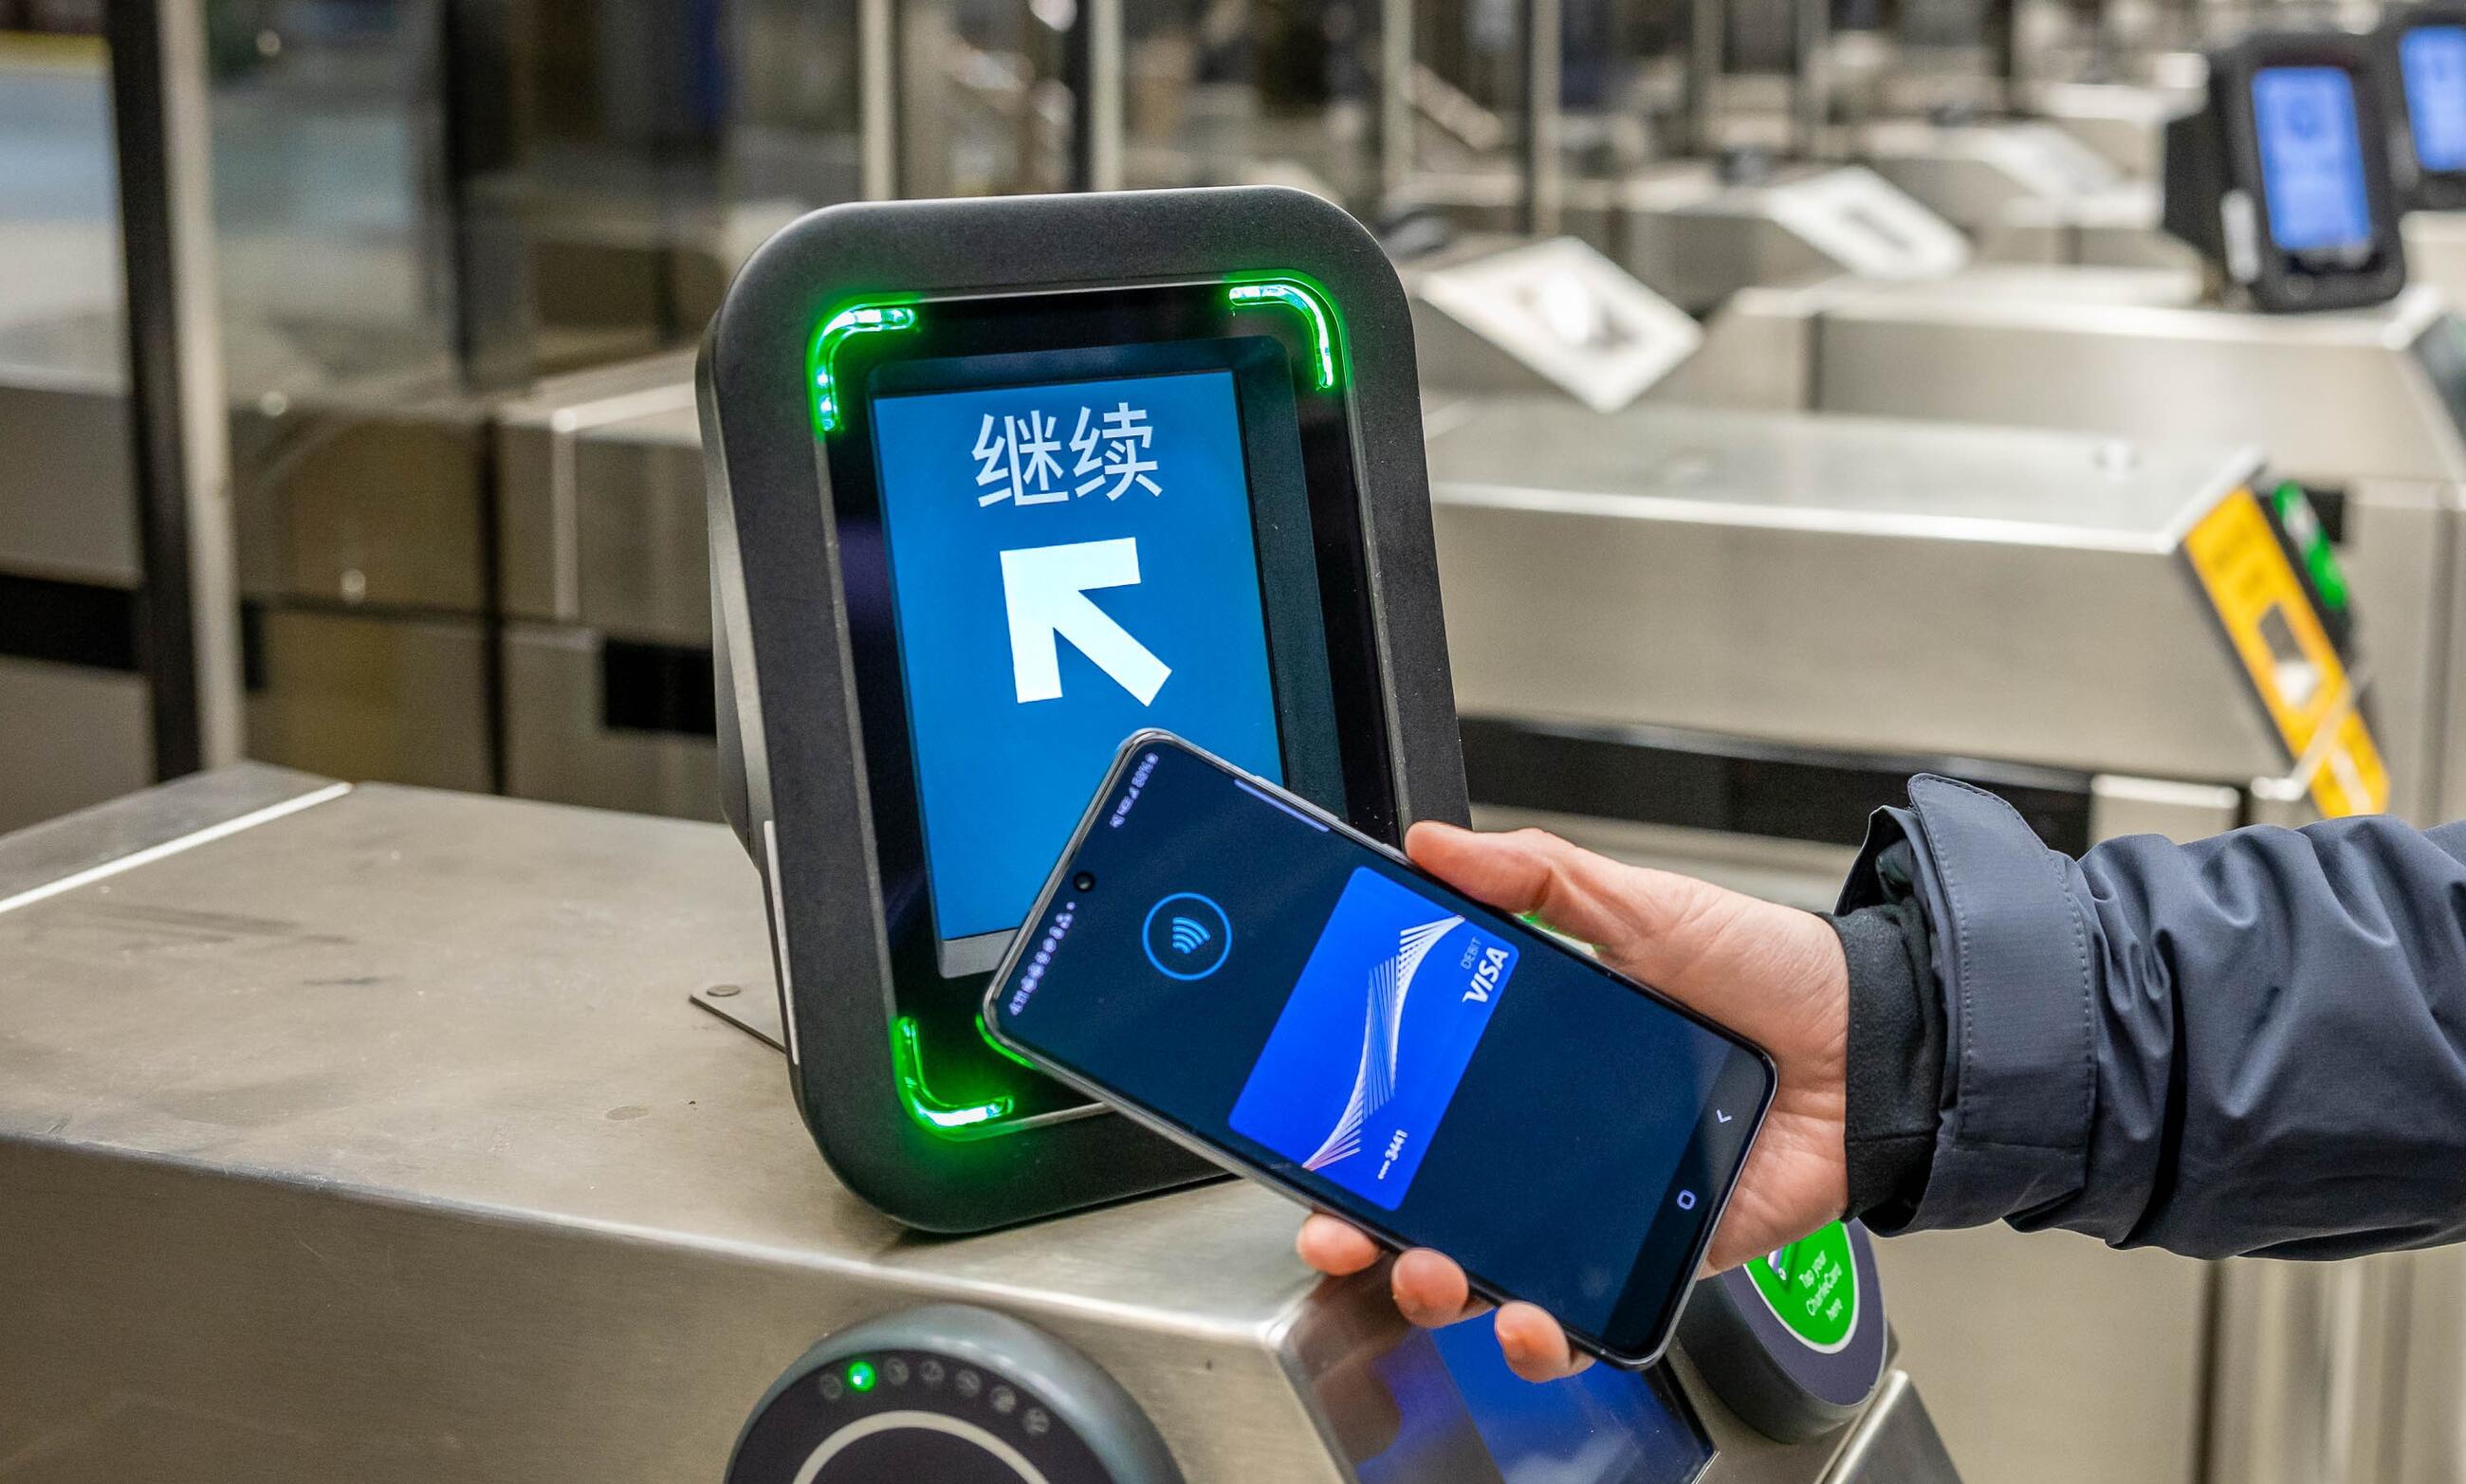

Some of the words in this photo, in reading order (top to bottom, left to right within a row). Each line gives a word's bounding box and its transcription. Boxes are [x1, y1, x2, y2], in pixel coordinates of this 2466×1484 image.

[971, 402, 1163, 508] 继续
[1461, 937, 1481, 969] DEBIT
[1462, 946, 1509, 1002] VISA
[1385, 1128, 1408, 1162] 3441
